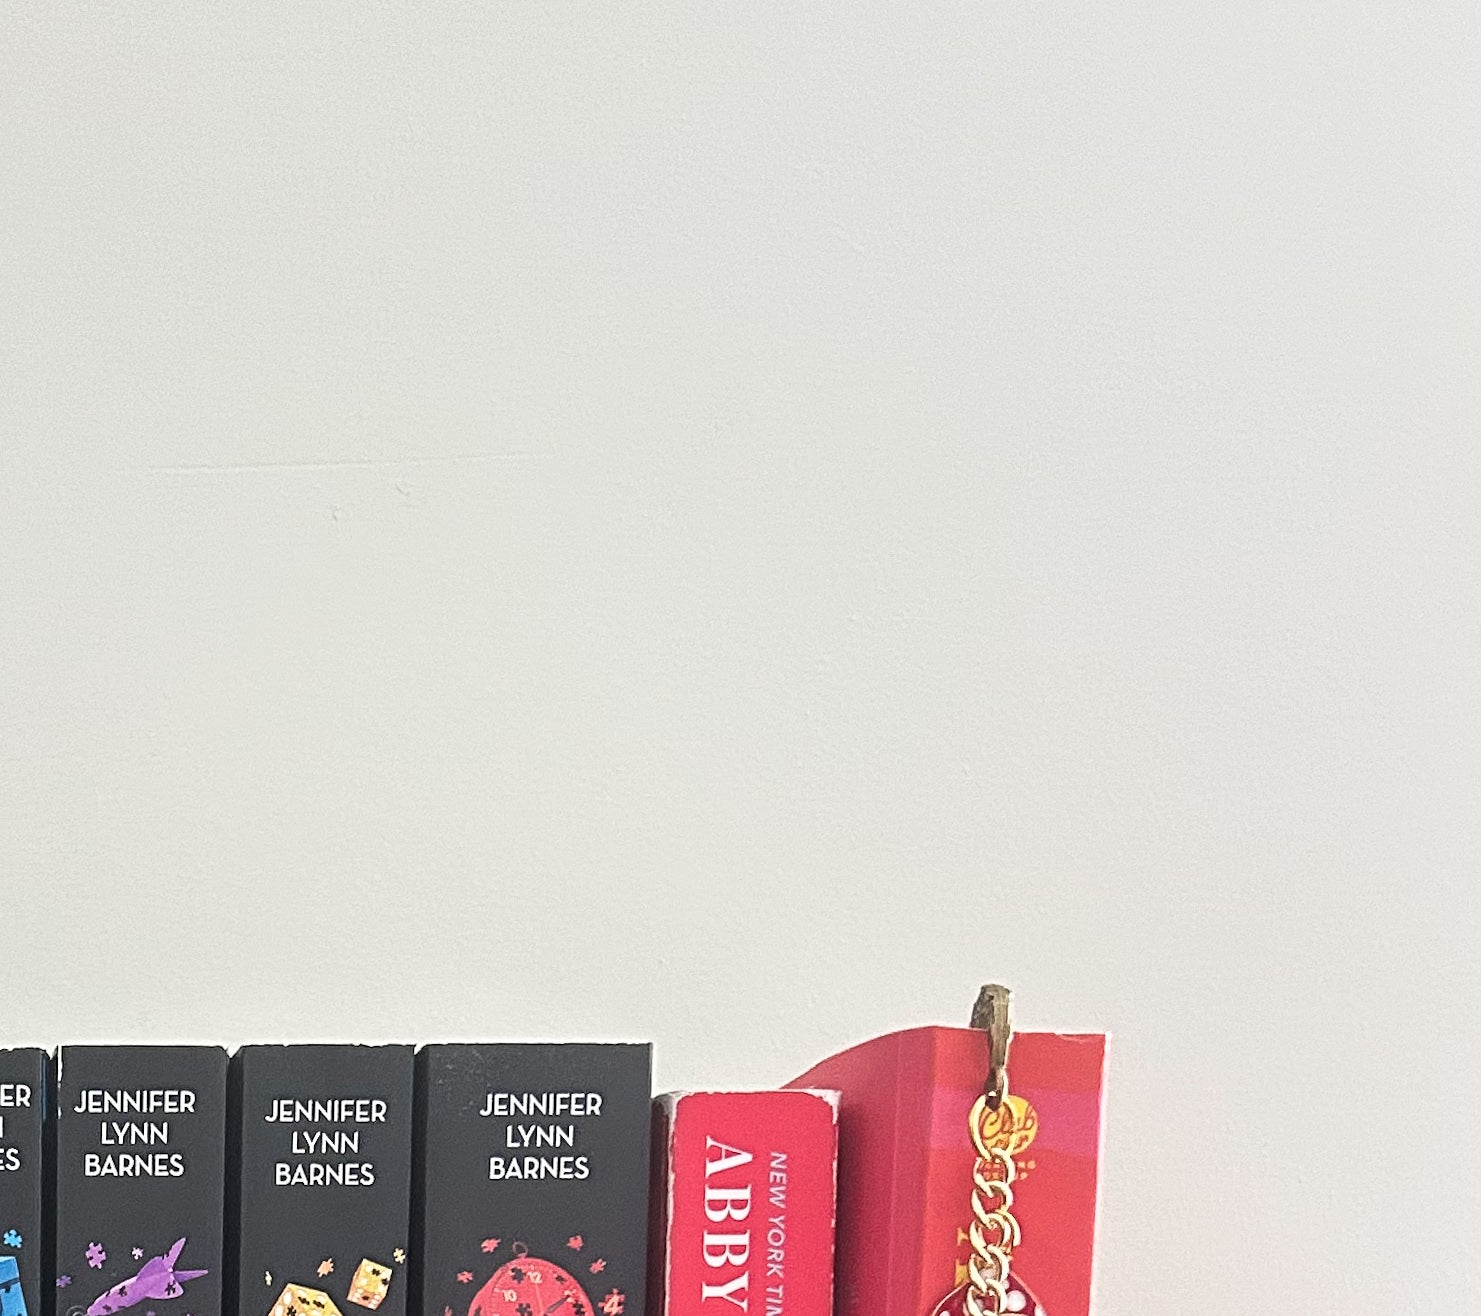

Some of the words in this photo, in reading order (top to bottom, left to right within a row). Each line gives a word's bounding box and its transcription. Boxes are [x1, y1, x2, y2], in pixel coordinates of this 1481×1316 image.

[73, 1088, 196, 1115] JENNIFER
[265, 1098, 388, 1125] JENNIFER
[478, 1091, 603, 1119] JENNIFER
[100, 1120, 170, 1146] LYNN
[290, 1131, 360, 1156] LYNN
[505, 1125, 575, 1150] LYNN
[83, 1153, 185, 1178] BARNES
[275, 1162, 376, 1187] BARNES
[488, 1155, 591, 1181] BARNES
[769, 1152, 788, 1209] NEW
[701, 1136, 753, 1313] ABBY
[766, 1214, 786, 1278] YORK
